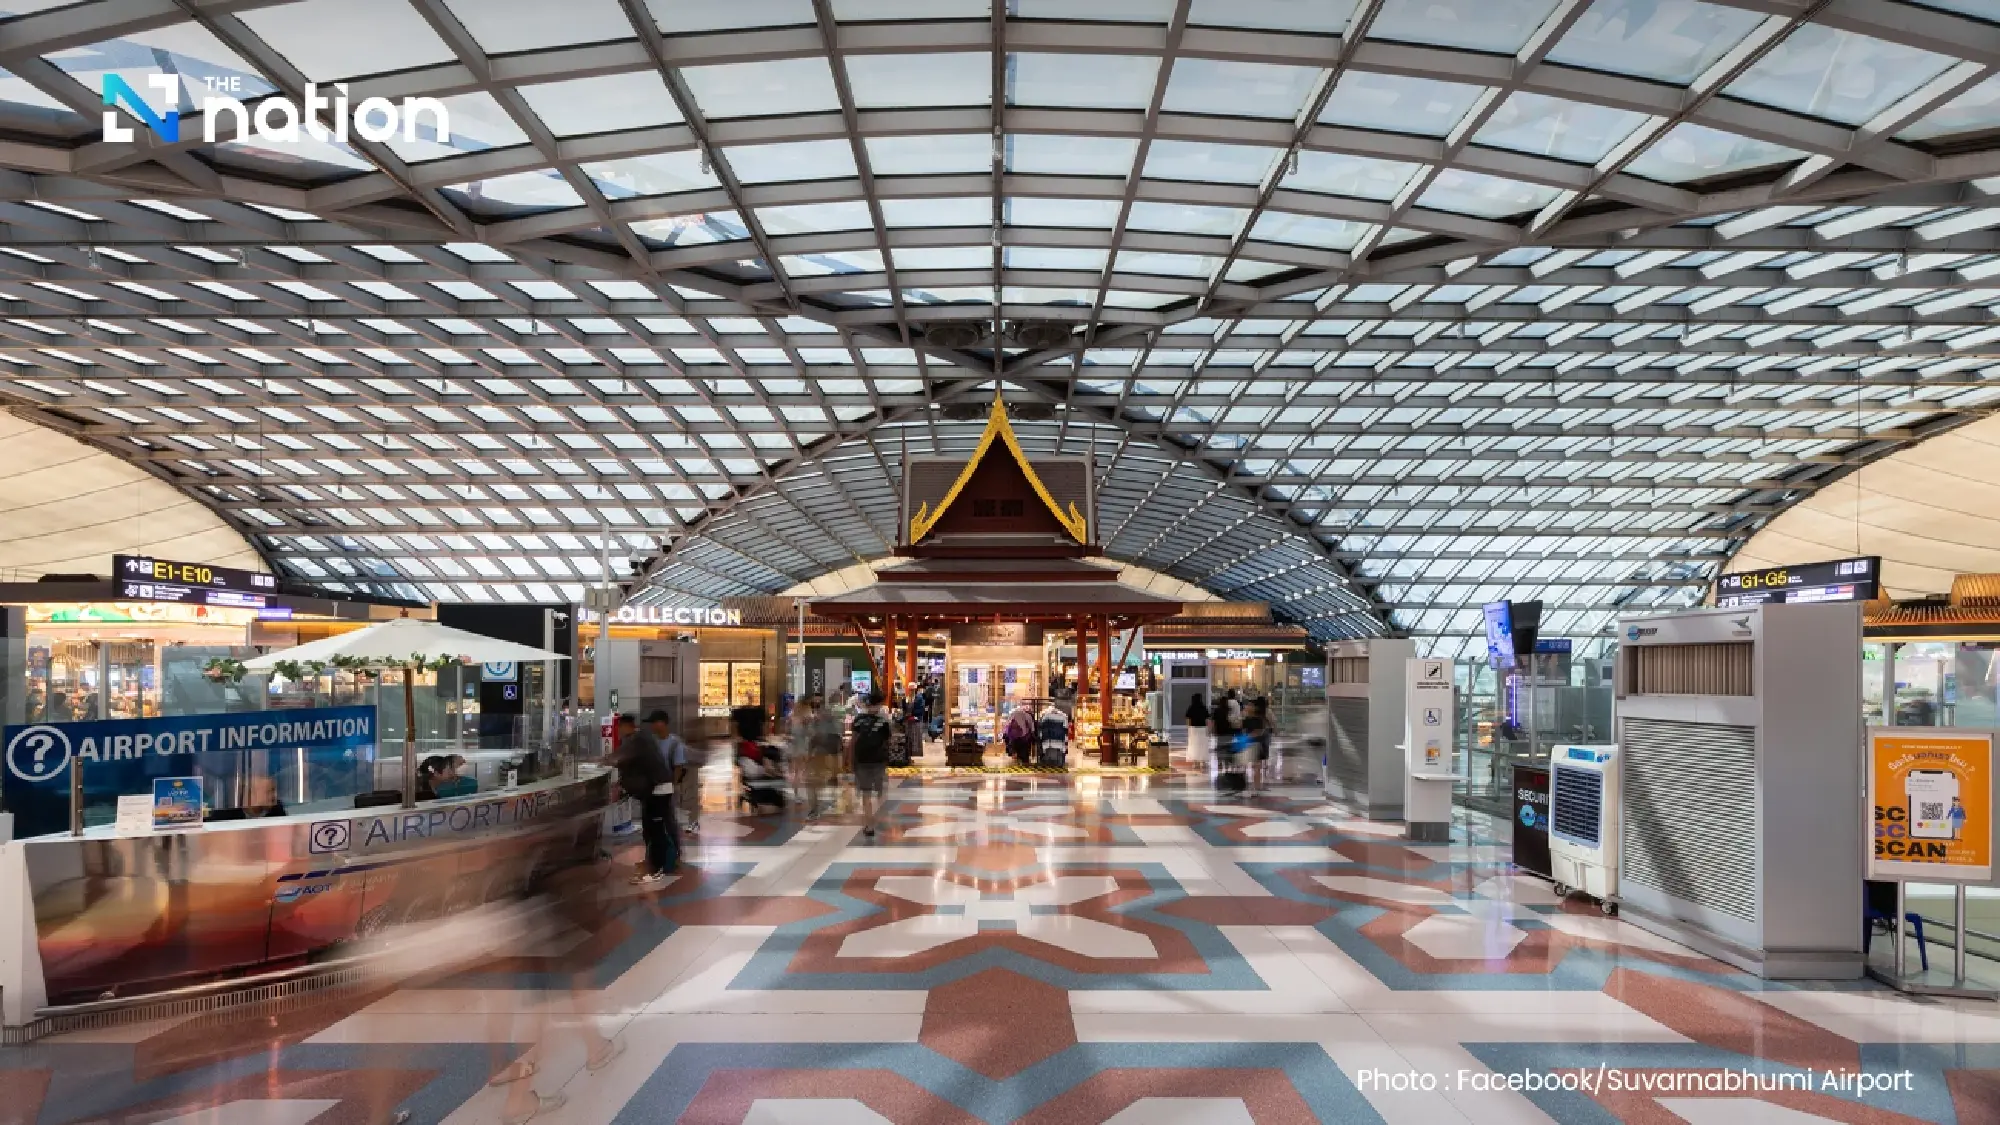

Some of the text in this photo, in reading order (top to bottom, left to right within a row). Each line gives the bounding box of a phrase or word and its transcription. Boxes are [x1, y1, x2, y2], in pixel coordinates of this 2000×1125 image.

[154, 561, 212, 584] E1-E10
[1741, 570, 1787, 589] G1-G5
[608, 605, 741, 626] OLLECTION
[77, 715, 370, 763] AIRPORT INFORMATION
[364, 801, 508, 847] AIRPORT
